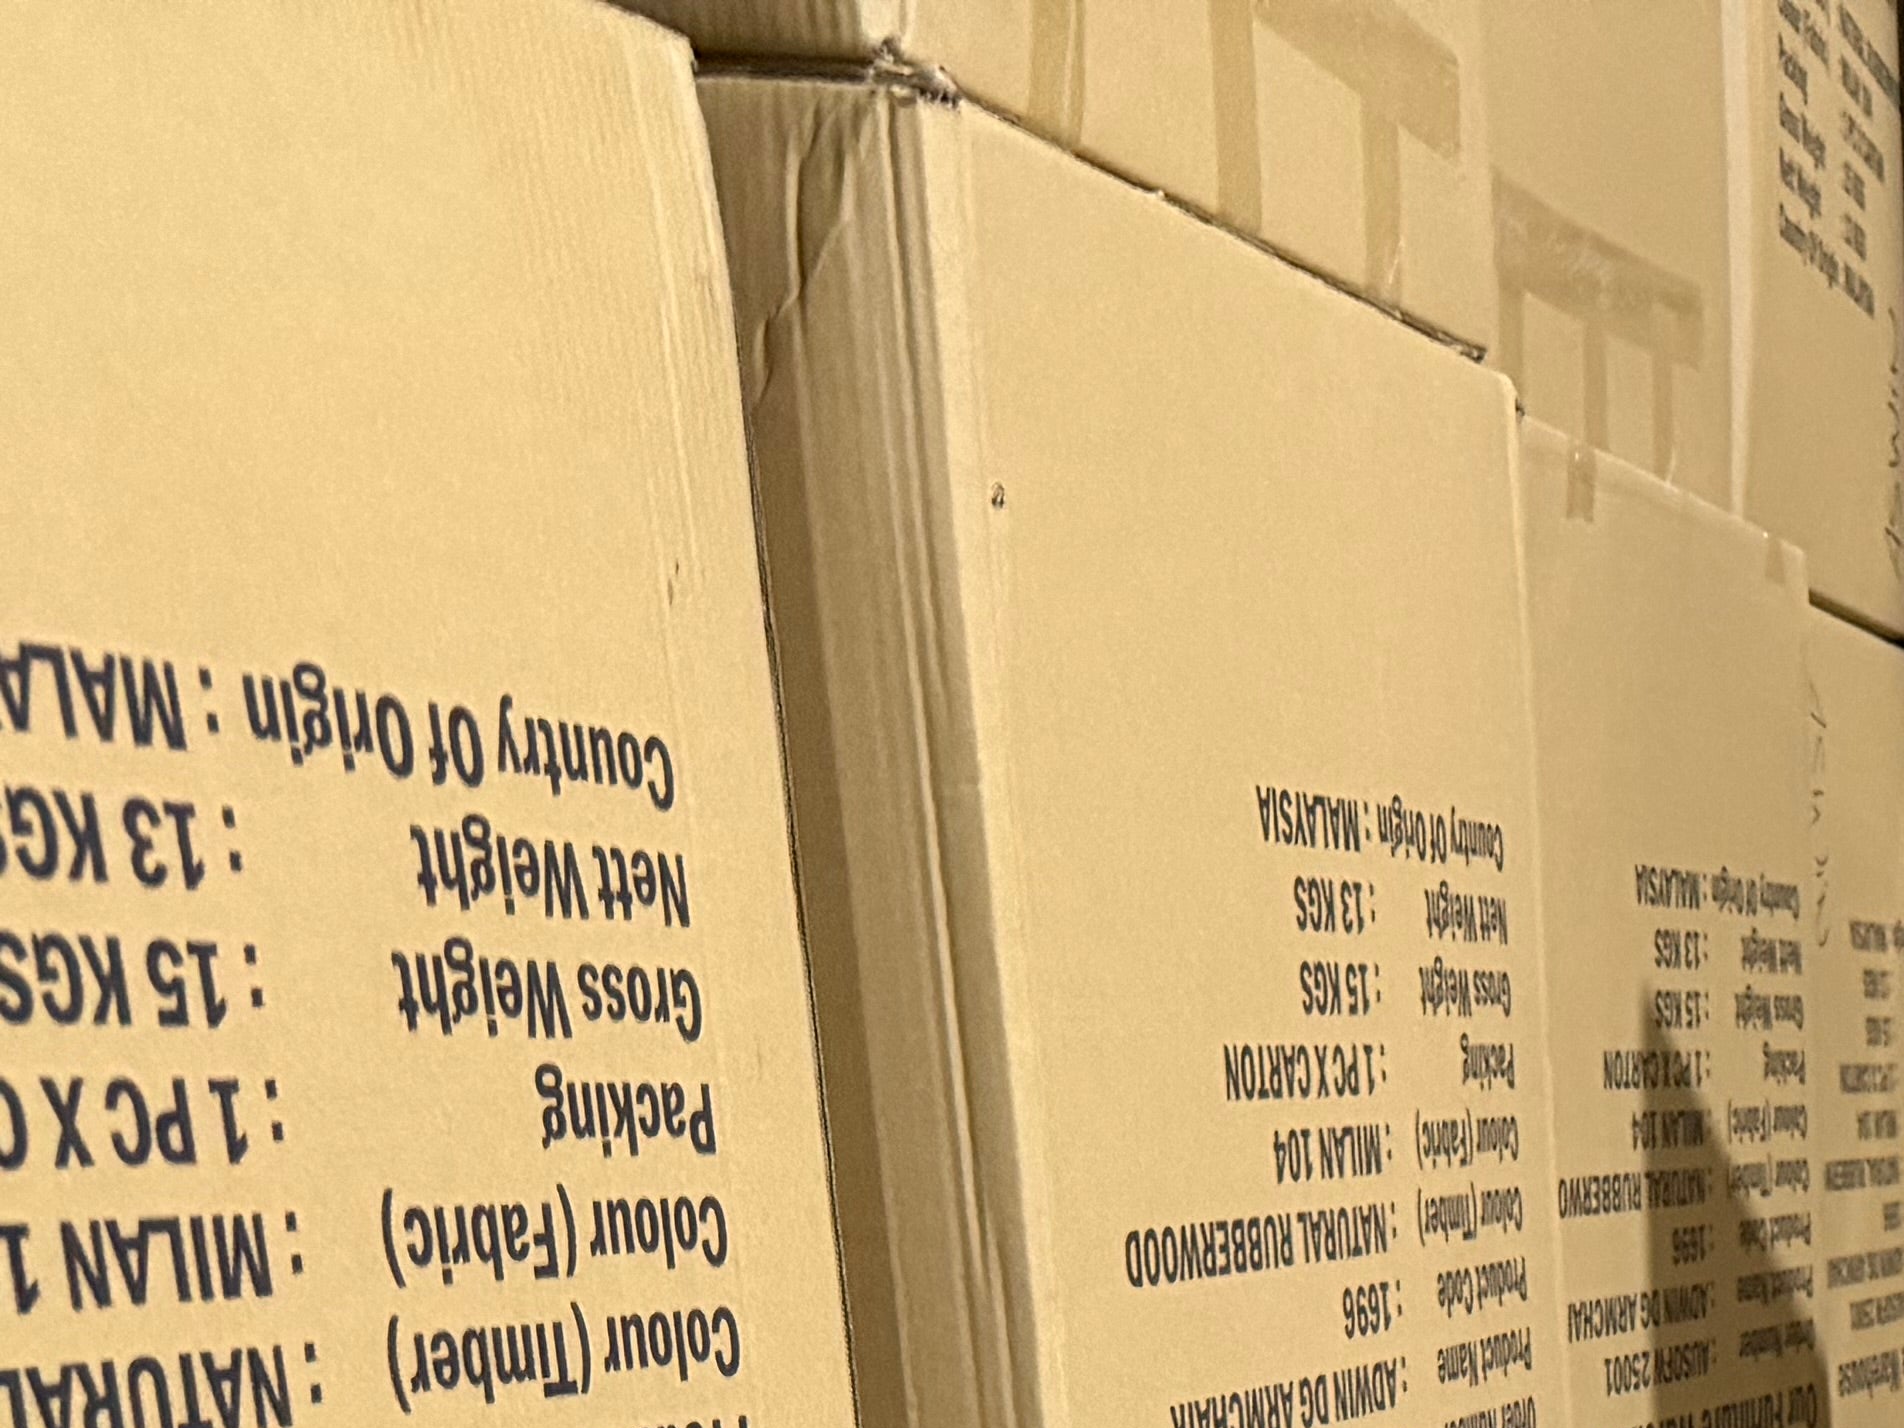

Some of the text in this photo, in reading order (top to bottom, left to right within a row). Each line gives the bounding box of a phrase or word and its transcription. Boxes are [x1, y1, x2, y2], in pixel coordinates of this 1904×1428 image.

[241, 661, 415, 780] Origin
[427, 701, 485, 789] Of
[497, 693, 675, 813] Country
[0, 785, 691, 929] Nett Weight 13 KG
[1255, 784, 1361, 853] MALAYSIA
[145, 937, 227, 1030] 15
[390, 935, 573, 1040] Weight
[576, 962, 703, 1045] Gross
[38, 1062, 717, 1170] Packing 1 PC X
[1223, 1043, 1312, 1102] CARTON
[1272, 1123, 1383, 1185] MILAN 104
[59, 1182, 728, 1313] Colour (Fabric) MILAN
[1124, 1202, 1388, 1288] NATURAL RUBBERWOOD
[603, 1305, 741, 1383] Colour
[1342, 1281, 1392, 1340] 1696
[1567, 1293, 1638, 1344] ARMCHAI
[386, 1300, 592, 1415] (Timber)
[1332, 1357, 1397, 1422] ADWIN
